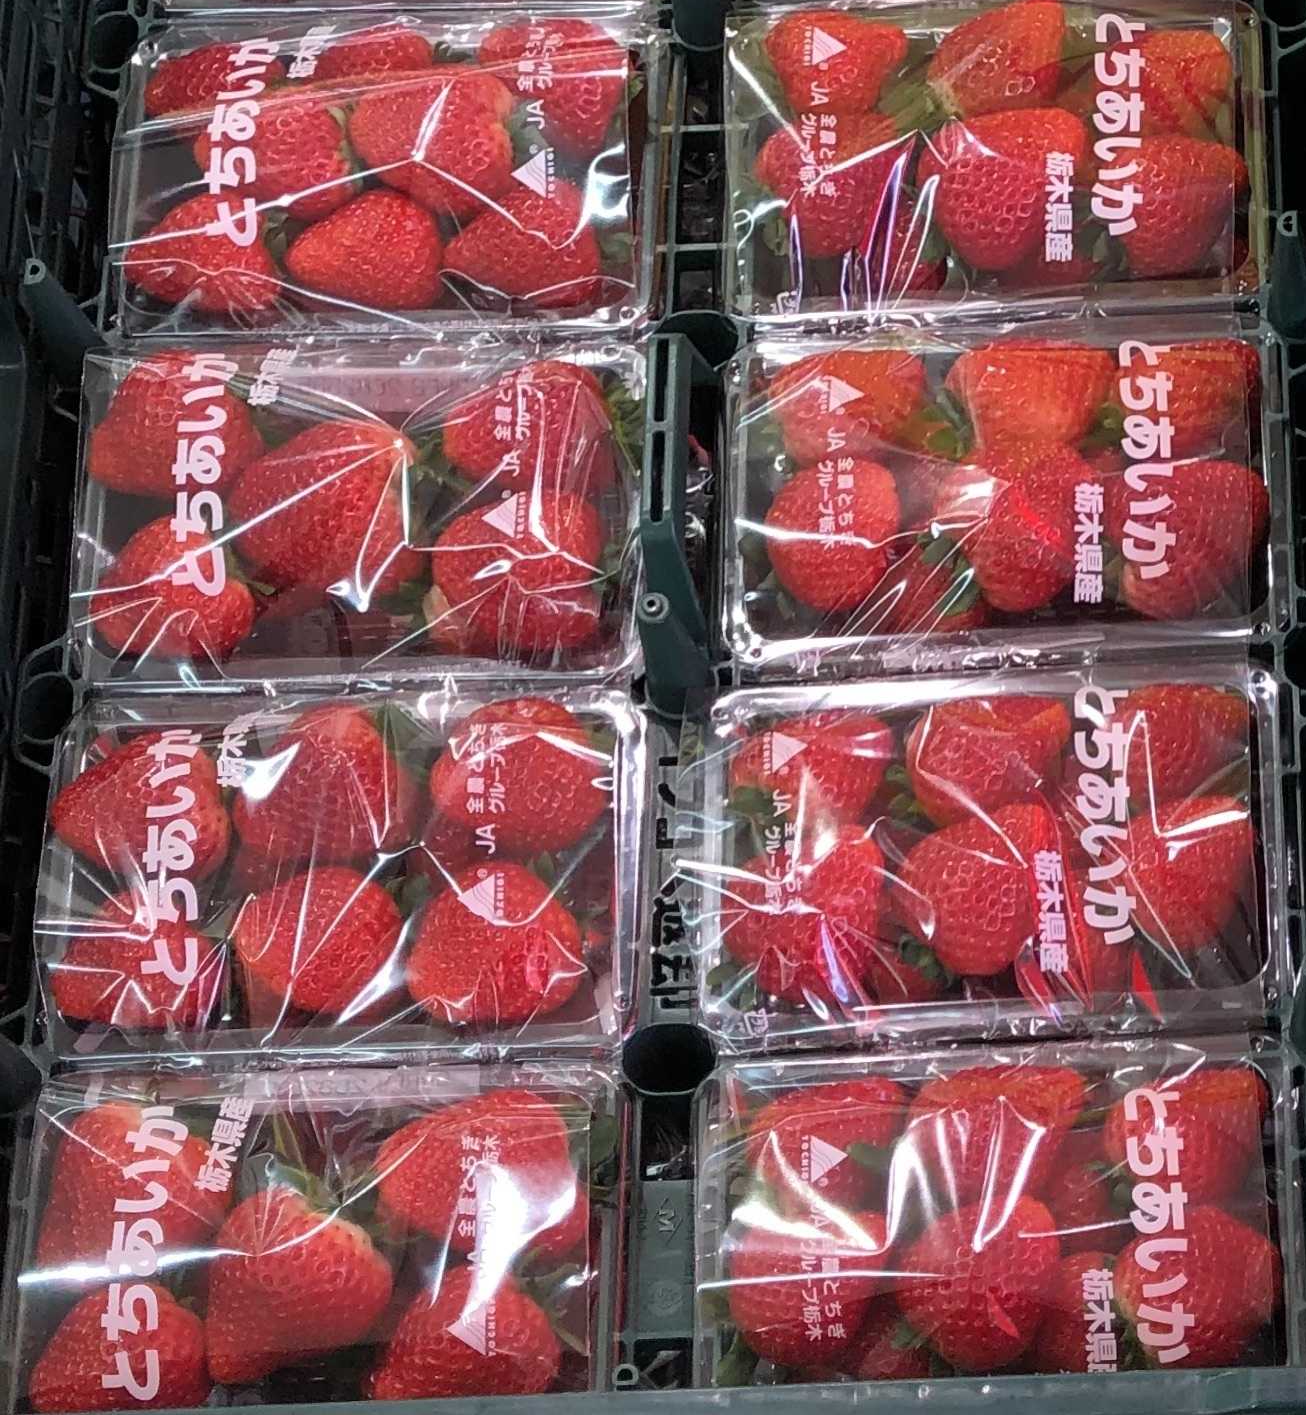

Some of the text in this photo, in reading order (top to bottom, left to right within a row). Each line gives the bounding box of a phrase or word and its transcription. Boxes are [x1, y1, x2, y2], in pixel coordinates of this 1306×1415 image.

[203, 36, 281, 247] とちあいか
[526, 98, 545, 130] JA
[810, 80, 830, 106] JA
[1091, 13, 1147, 235] とちあいか
[1044, 150, 1075, 263] 栃木県産
[171, 353, 240, 597] とちあいか
[500, 447, 522, 478] JA
[826, 426, 847, 453] JA
[1118, 340, 1178, 581] とちあいか
[1073, 482, 1105, 605] 栃木県産
[139, 729, 202, 986] とちあいか
[475, 823, 496, 854] JA
[772, 788, 792, 818] JA
[1073, 684, 1138, 945] とちあいか
[1033, 849, 1071, 975] 栃木県産
[193, 1094, 256, 1195] 栃木県産
[101, 1107, 190, 1402] とちあいか
[1124, 1087, 1197, 1365] とちあいか
